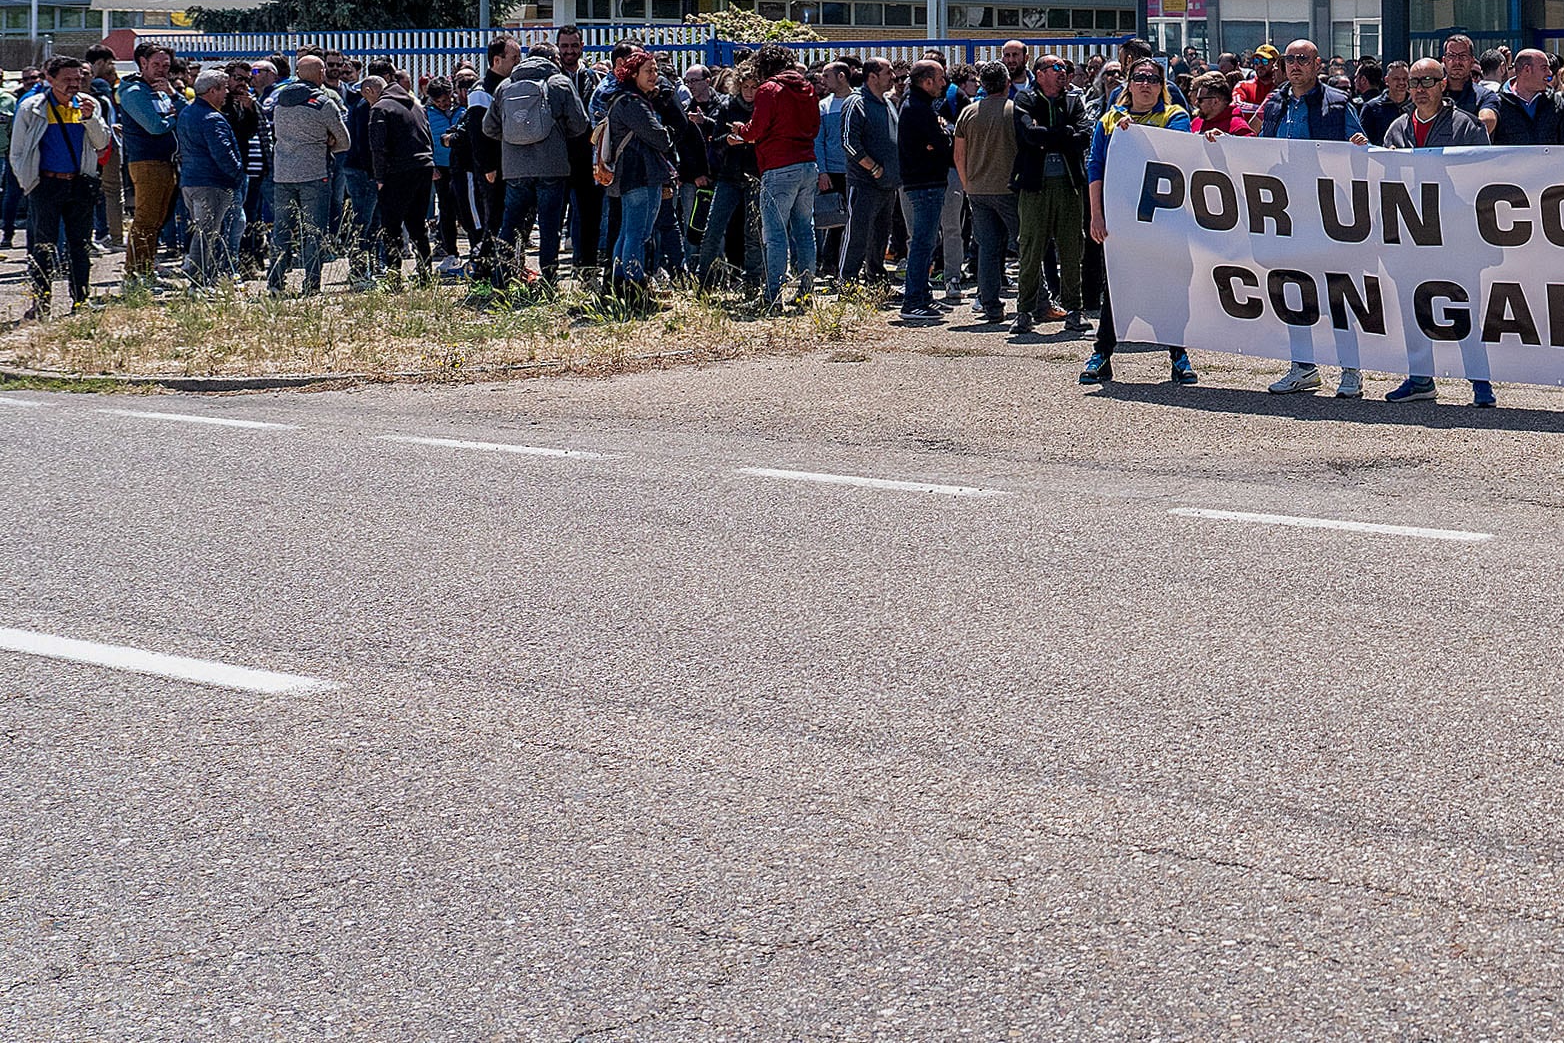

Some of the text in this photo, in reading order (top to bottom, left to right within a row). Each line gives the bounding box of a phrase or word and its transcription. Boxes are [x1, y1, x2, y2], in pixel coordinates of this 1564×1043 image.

[1137, 161, 1293, 237] POR
[1317, 178, 1443, 247] UN
[1212, 265, 1387, 336] CON
